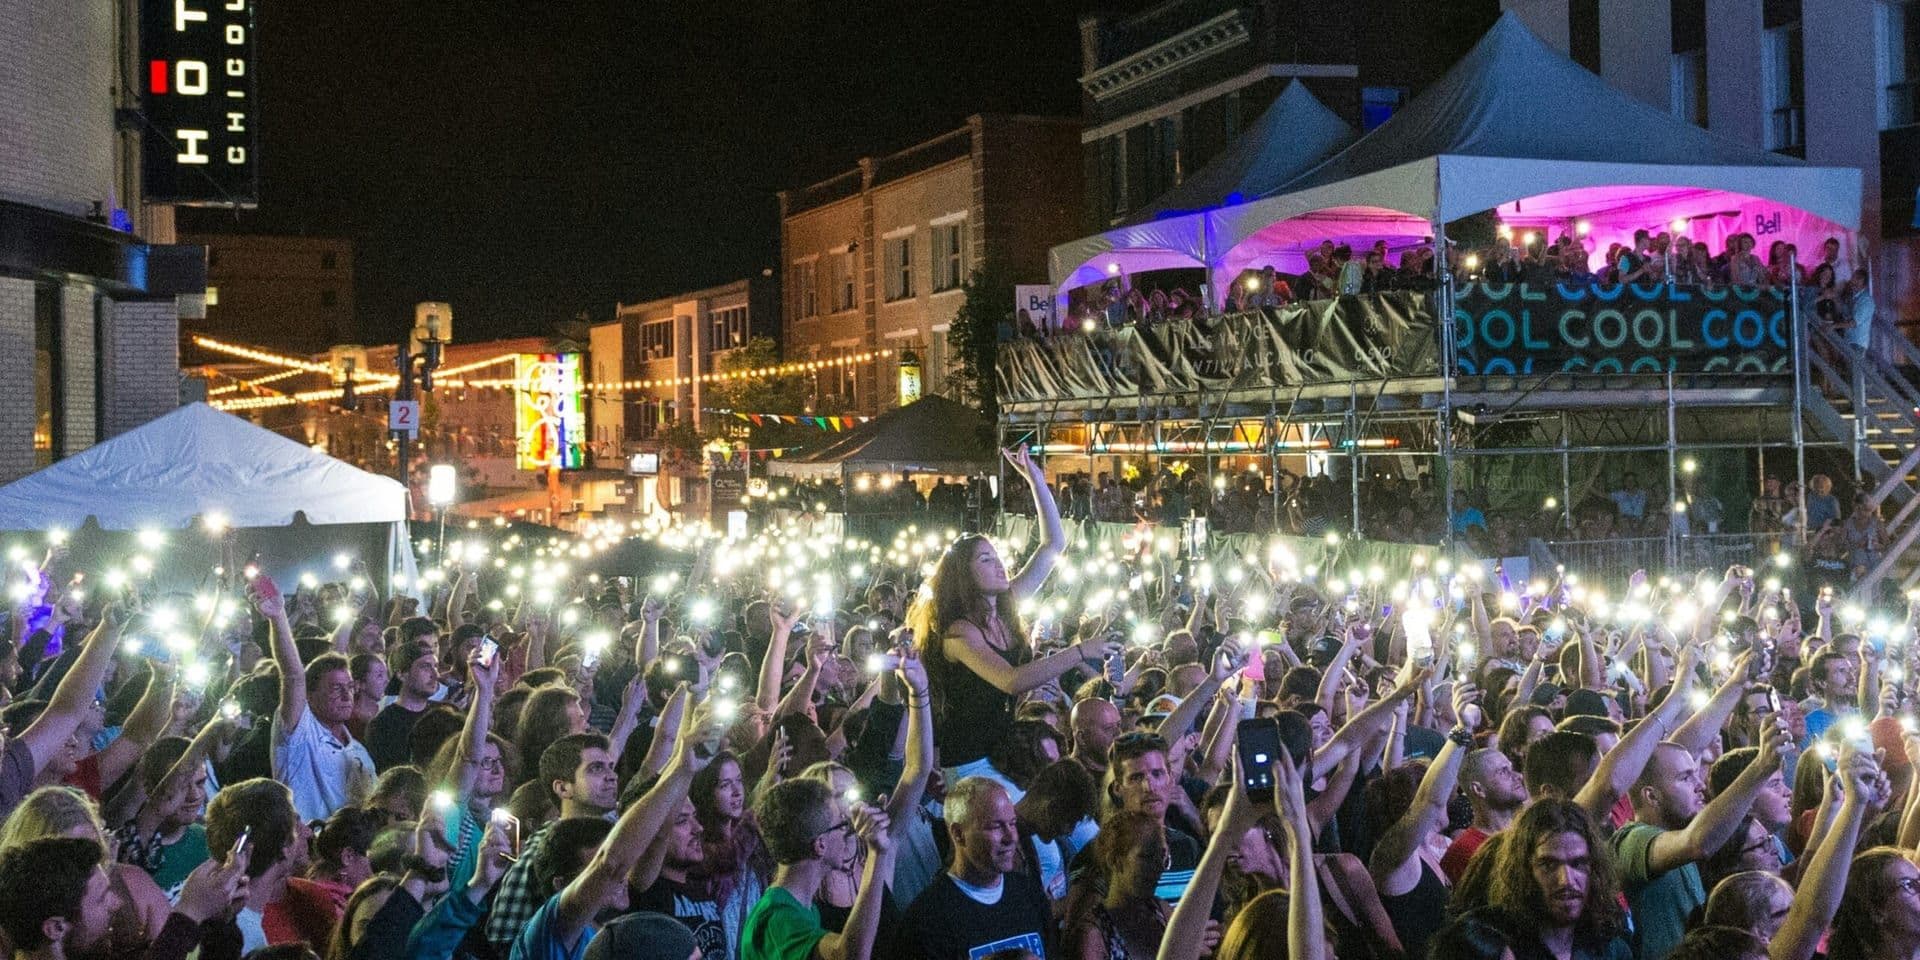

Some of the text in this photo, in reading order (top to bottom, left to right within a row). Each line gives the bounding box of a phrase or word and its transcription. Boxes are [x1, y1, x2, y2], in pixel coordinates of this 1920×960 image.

[175, 0, 209, 164] HOT
[1756, 211, 1781, 235] Bell
[1559, 309, 1694, 348] COOL
[398, 406, 410, 424] 2
